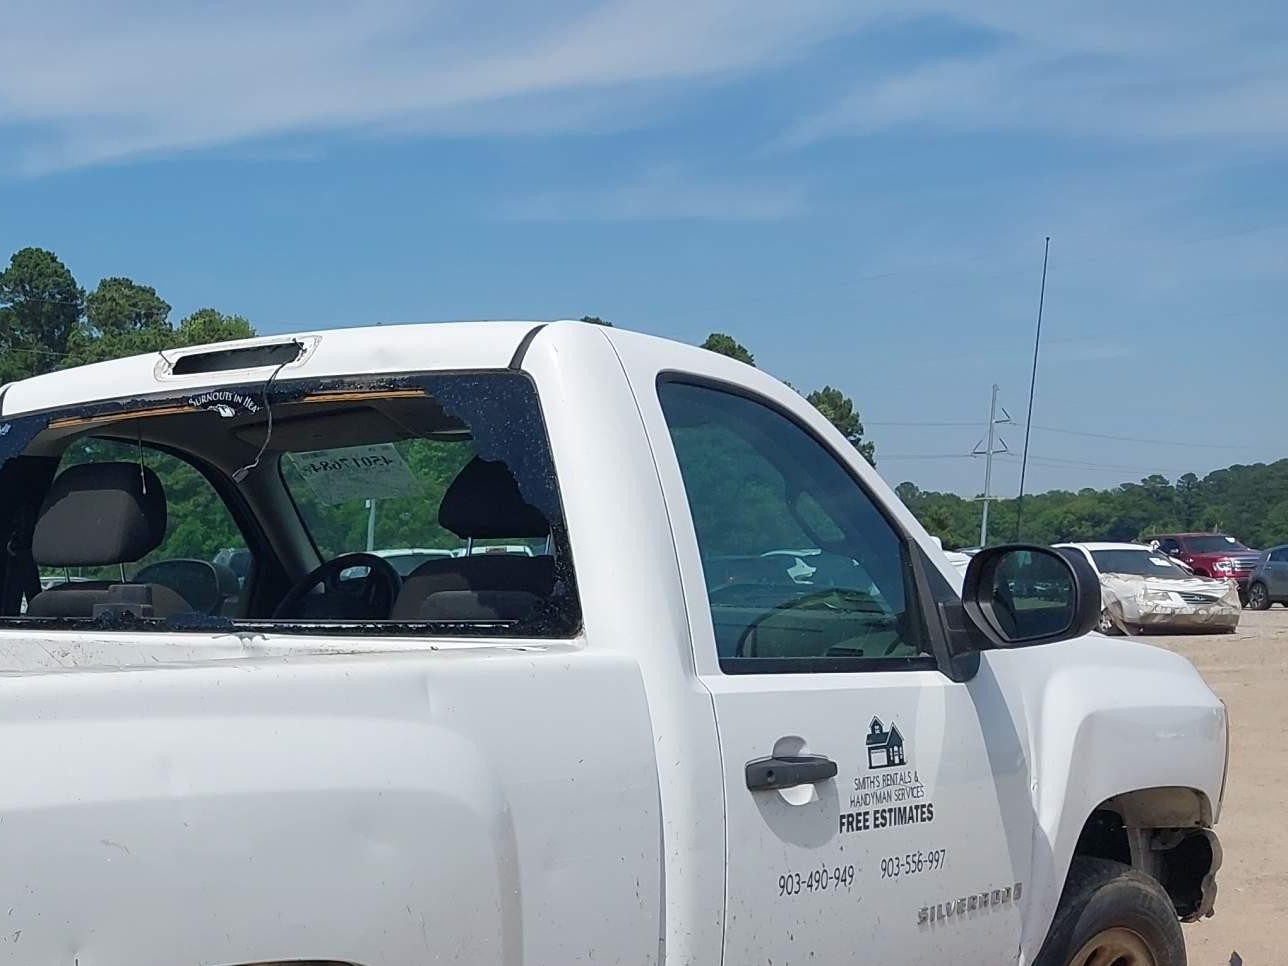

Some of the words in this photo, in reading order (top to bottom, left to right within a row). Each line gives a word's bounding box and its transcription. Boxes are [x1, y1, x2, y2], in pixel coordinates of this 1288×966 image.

[233, 393, 243, 404] IN
[242, 395, 260, 413] HEA
[854, 776, 880, 791] SMITH'S
[881, 773, 912, 787] RENTALS
[913, 771, 919, 783] &
[850, 790, 892, 808] HANDYMAN
[894, 786, 924, 801] SERVICES
[839, 811, 871, 834] FREE
[873, 803, 934, 828] ESTIMATES
[778, 865, 855, 897] 903-490-949
[880, 850, 946, 879] 903-556-997
